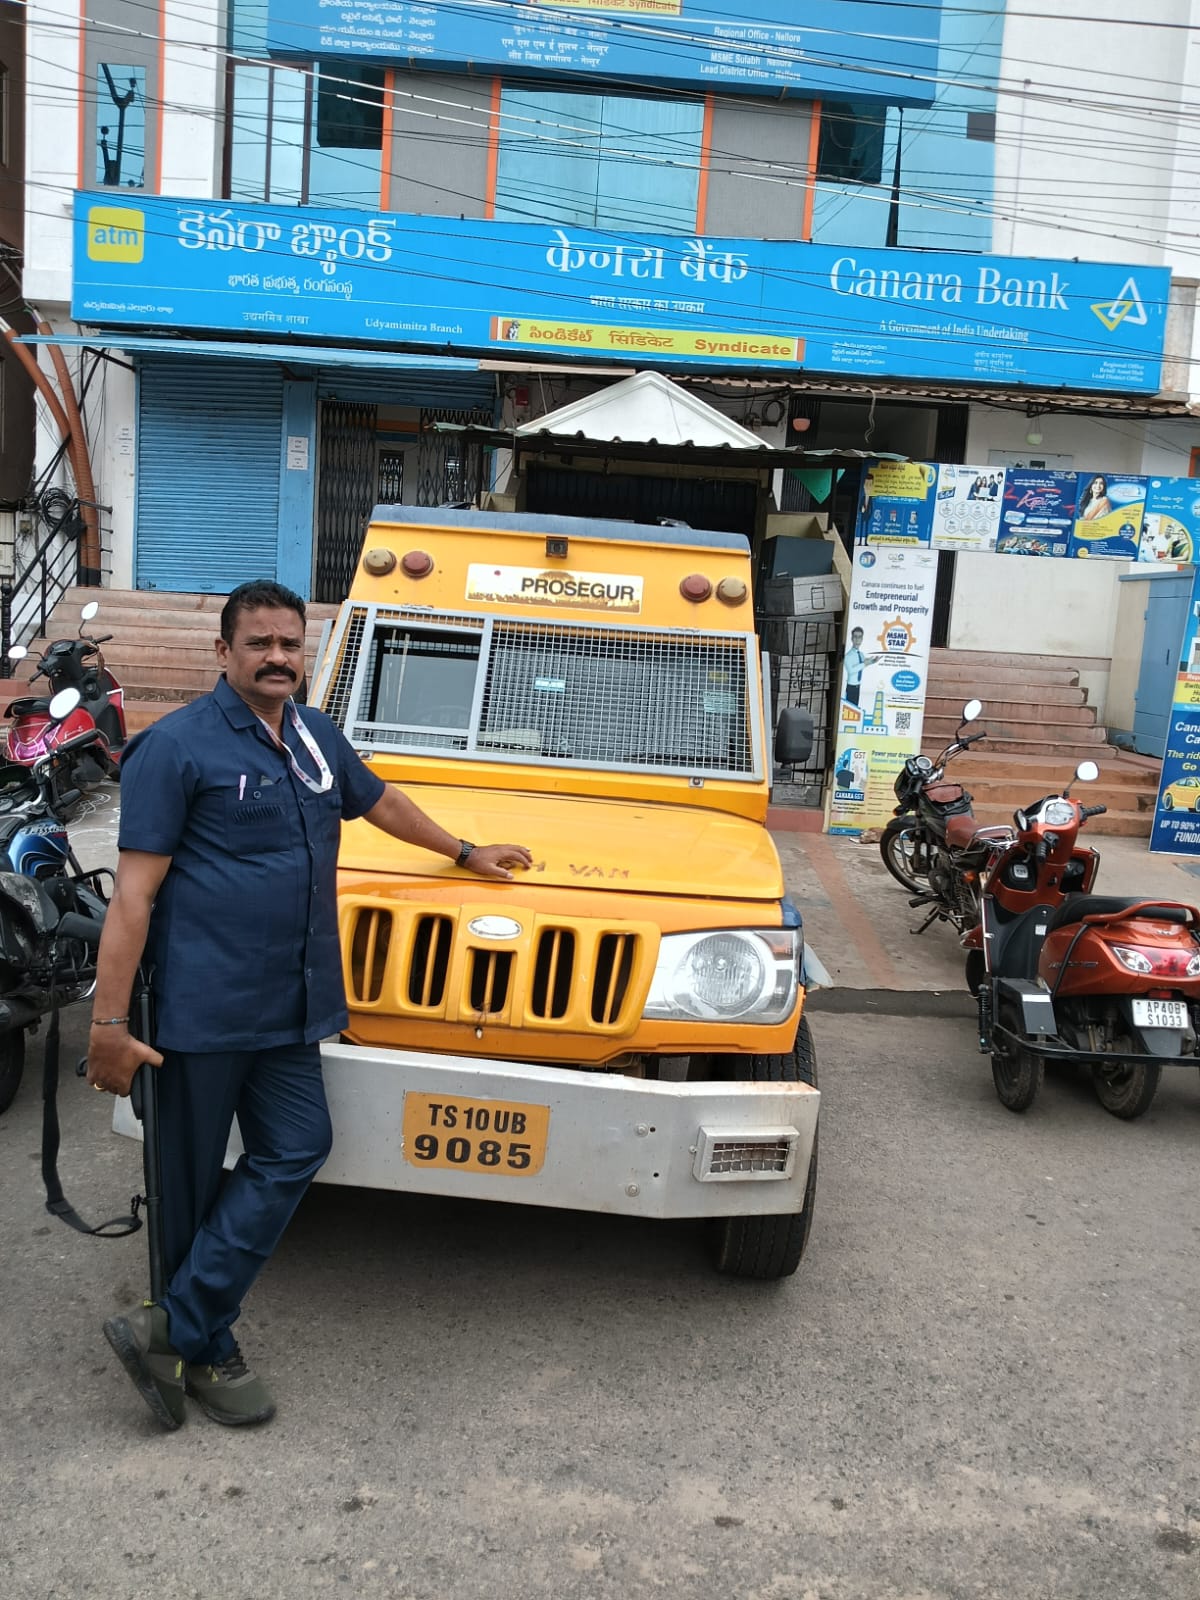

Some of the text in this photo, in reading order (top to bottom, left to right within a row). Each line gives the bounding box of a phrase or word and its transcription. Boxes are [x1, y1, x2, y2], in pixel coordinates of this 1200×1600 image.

[713, 26, 746, 38] Regional
[747, 28, 770, 40] Office
[775, 31, 801, 43] Nellore
[711, 52, 734, 63] MSME
[735, 53, 761, 65] Sulabh
[700, 64, 719, 75] Lead
[720, 65, 746, 77] District
[747, 68, 770, 79] Office
[93, 226, 138, 247] atm
[177, 207, 397, 276] కెనరా బ్యాంక్
[546, 228, 749, 285] केनरा बैंक
[227, 273, 259, 288] భారత
[829, 256, 1070, 312] Canara Bank
[590, 294, 616, 309] भारत
[618, 296, 653, 312] सरकार
[654, 299, 670, 313] का
[364, 316, 463, 334] Udyamimitra Branch
[879, 320, 1029, 343] A Government of India Undertaking
[609, 329, 674, 348] सिंडिकेट
[695, 338, 792, 357] Syndicate
[521, 577, 635, 601] PROSEGUR
[861, 580, 881, 588] Canara
[881, 582, 907, 590] continues
[865, 590, 919, 602] Entrepreneurial
[853, 601, 929, 616] Growth and Prosperity
[886, 631, 908, 640] MSME
[887, 639, 906, 647] STAR
[853, 751, 866, 759] GST
[1167, 749, 1185, 759] The
[1182, 762, 1197, 771] Go
[835, 791, 854, 799] CANARA
[1160, 819, 1170, 829] UP
[1171, 820, 1180, 829] TO
[1148, 1014, 1182, 1027] S1033
[413, 1134, 532, 1170] 9085
